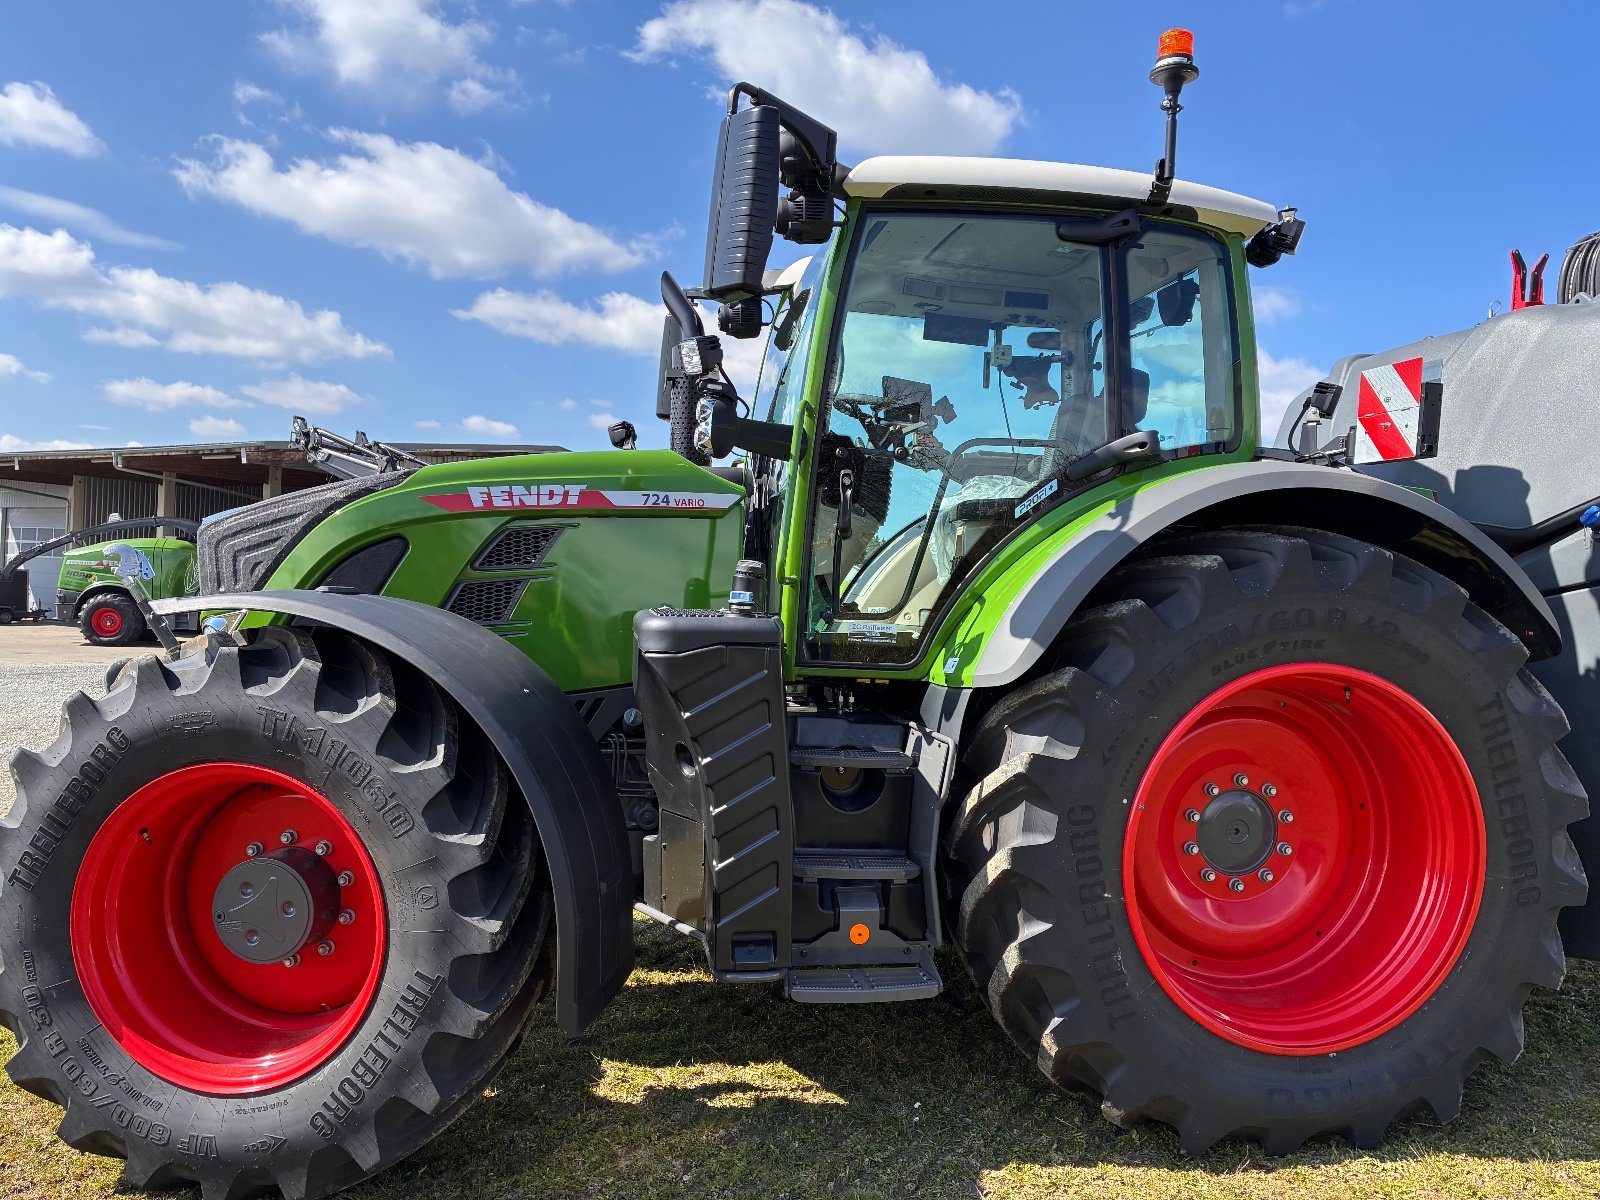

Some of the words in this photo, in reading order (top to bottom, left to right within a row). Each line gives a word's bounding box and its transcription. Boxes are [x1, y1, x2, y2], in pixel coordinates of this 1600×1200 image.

[466, 484, 588, 507] FENDT
[641, 493, 670, 506] 724
[673, 497, 705, 507] VARIO
[7, 725, 132, 893] TRELLEBORG
[1474, 691, 1542, 907] TRELLEBORG
[1066, 804, 1137, 1031] TRELLEBORG
[309, 969, 445, 1139] TRELLEBORG
[176, 1132, 218, 1157] VF
